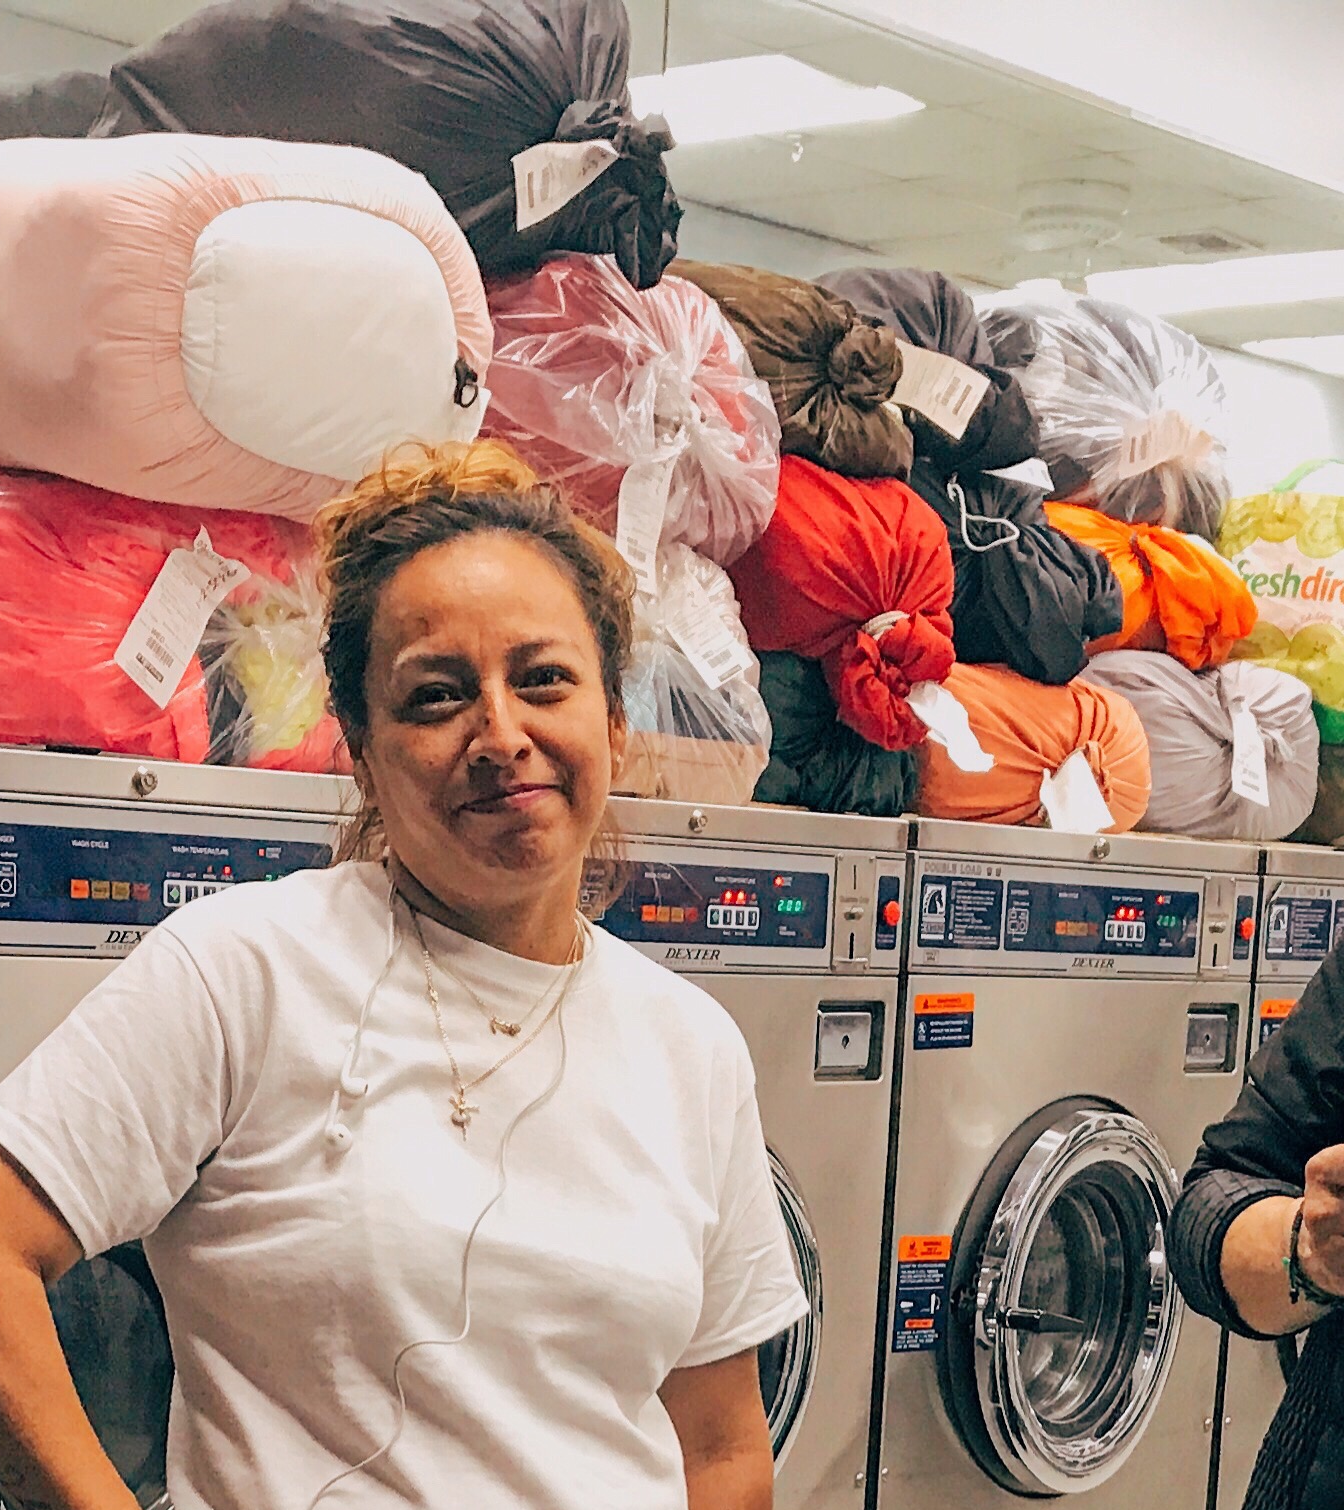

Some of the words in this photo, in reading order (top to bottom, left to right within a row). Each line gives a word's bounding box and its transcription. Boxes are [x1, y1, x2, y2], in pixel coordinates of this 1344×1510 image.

[104, 930, 147, 943] DEX
[665, 948, 720, 960] DEXTER
[1072, 958, 1115, 968] DEXTER
